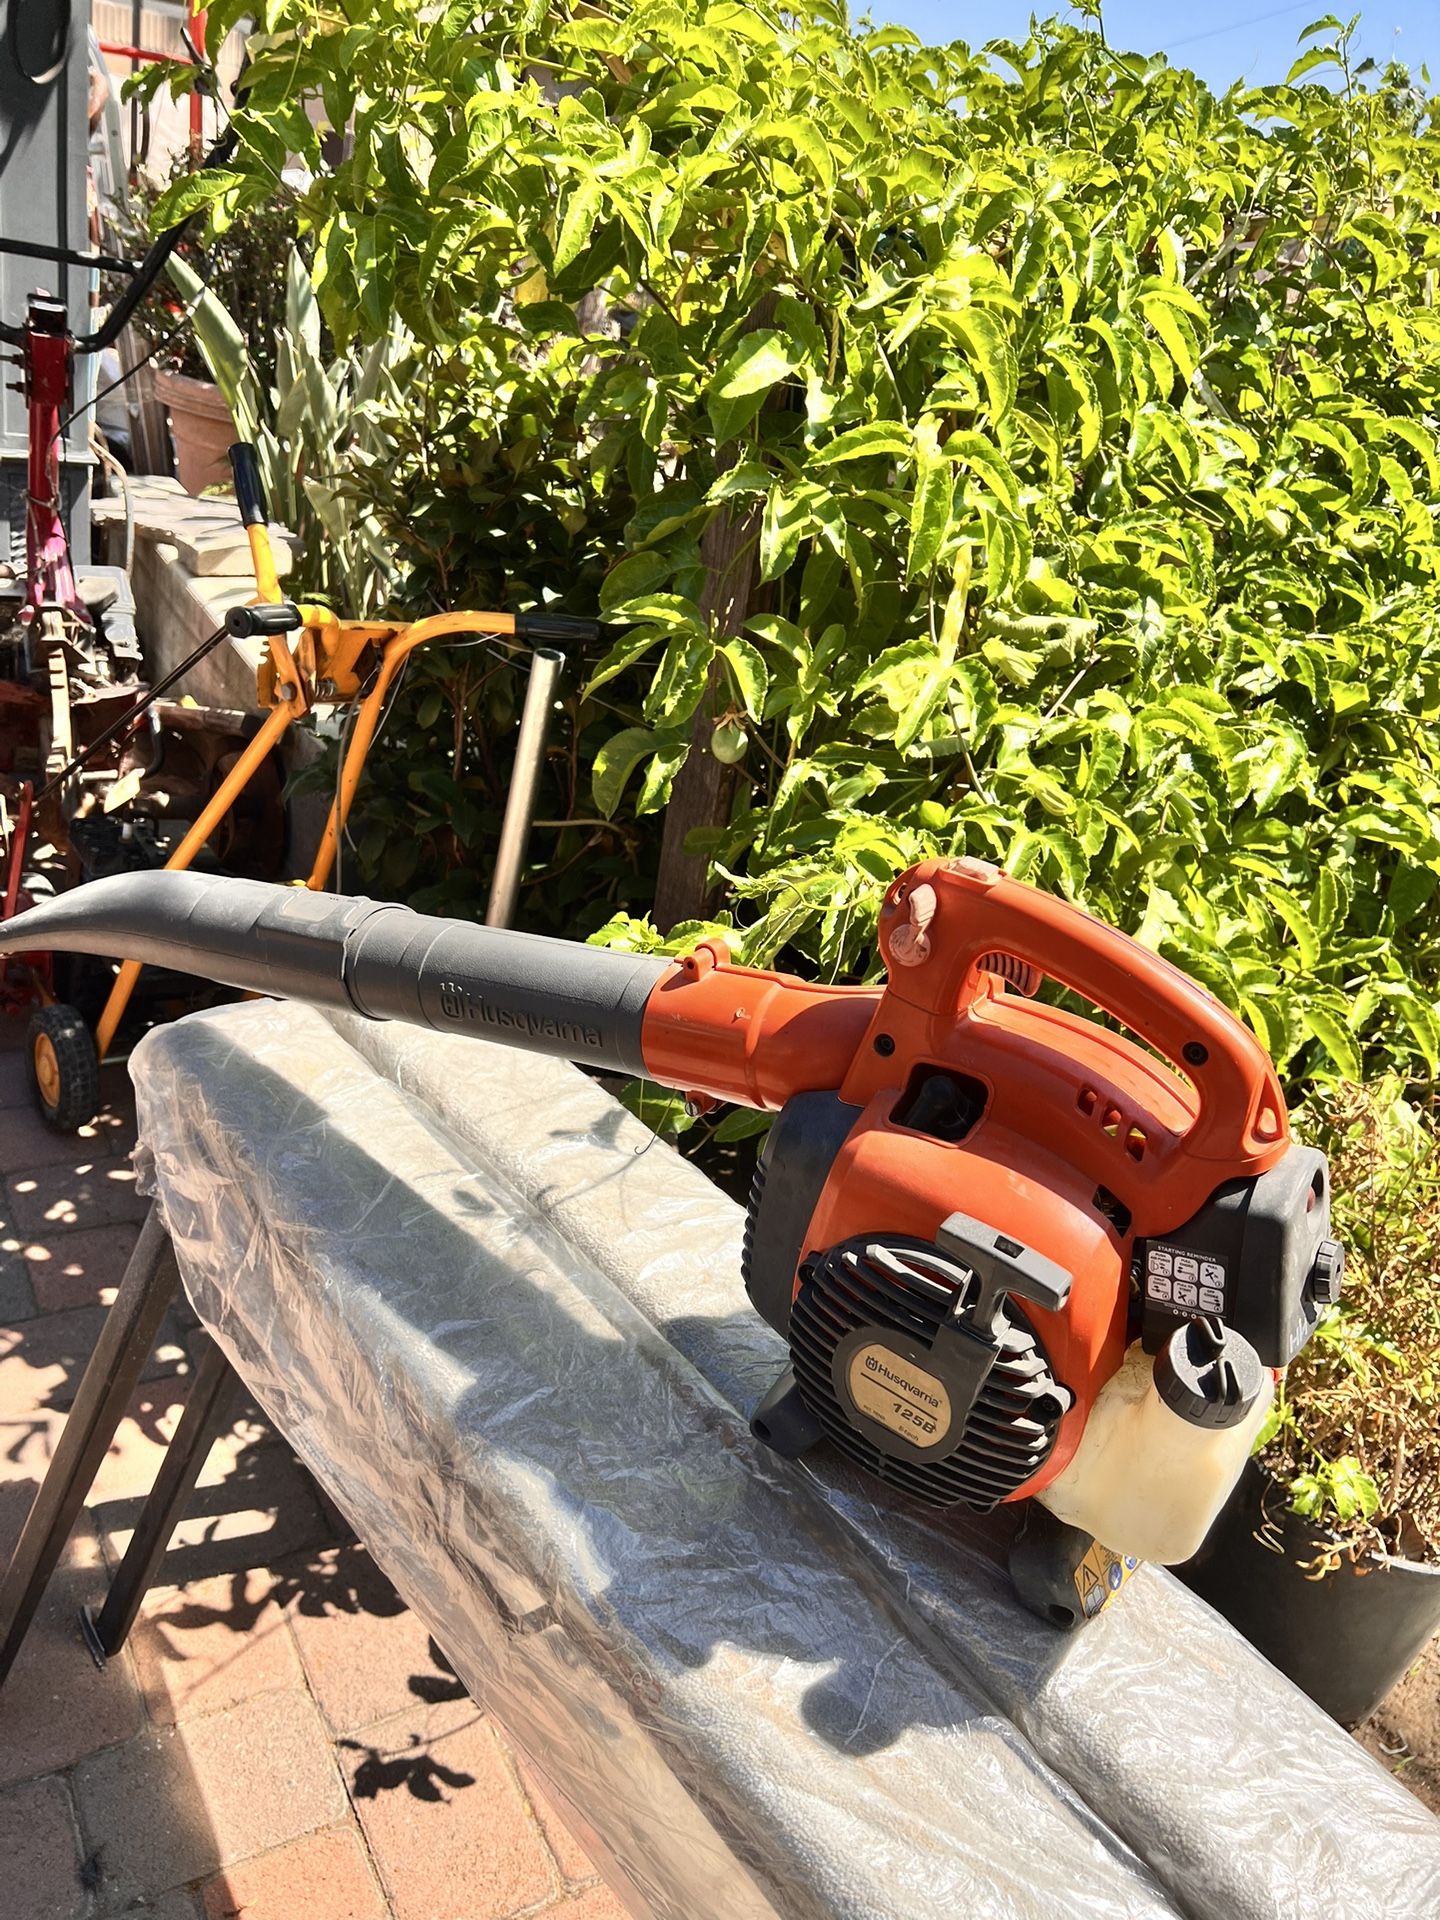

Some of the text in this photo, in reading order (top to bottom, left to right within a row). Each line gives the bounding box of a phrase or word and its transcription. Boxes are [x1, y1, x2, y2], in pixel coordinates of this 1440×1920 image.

[466, 992, 604, 1048] Husqvarna
[1157, 1245, 1217, 1263] STARTING REMINDER
[877, 1364, 939, 1409] Husqvarna
[892, 1403, 935, 1434] 125B
